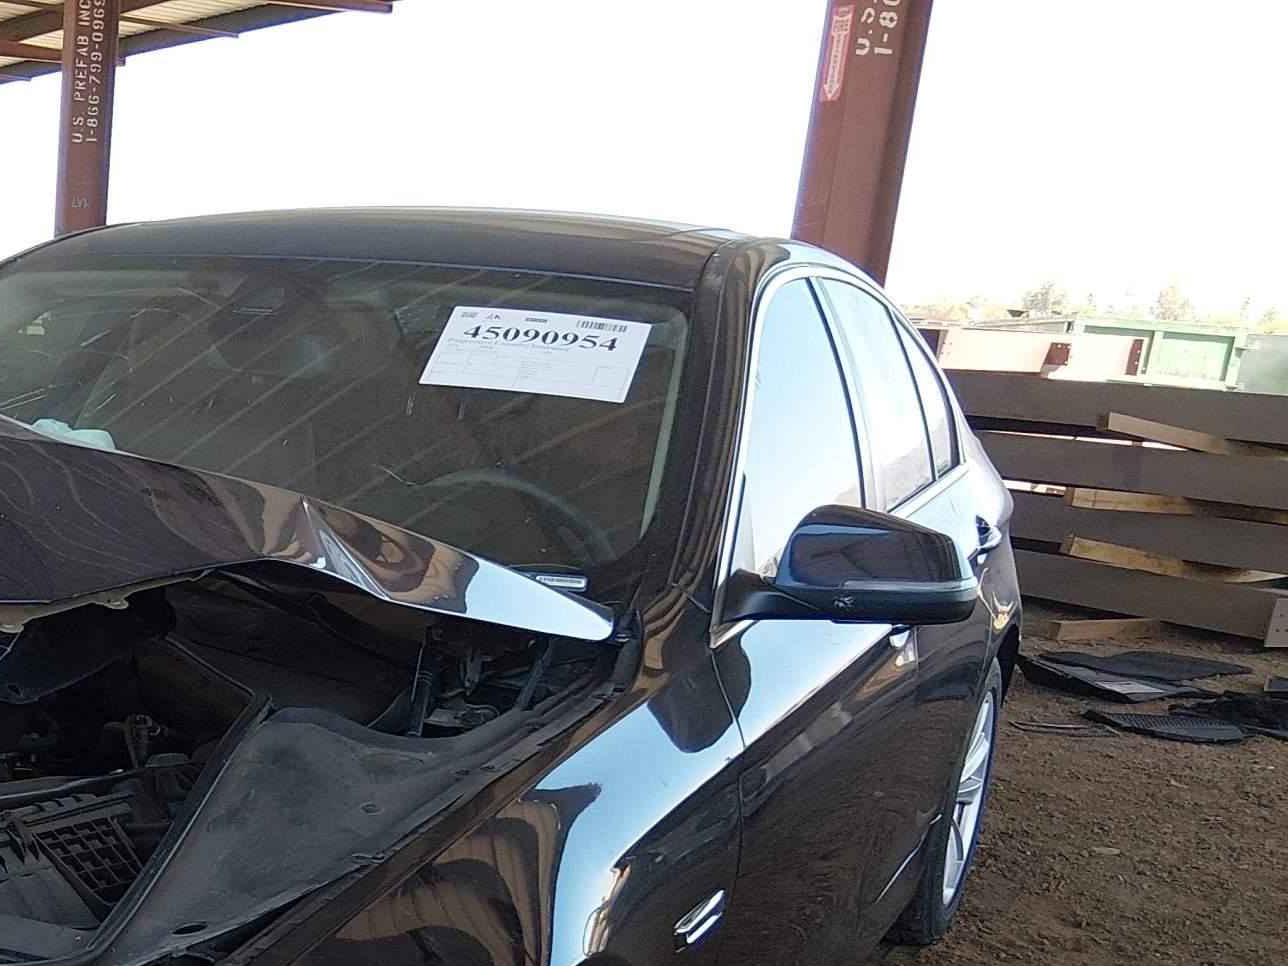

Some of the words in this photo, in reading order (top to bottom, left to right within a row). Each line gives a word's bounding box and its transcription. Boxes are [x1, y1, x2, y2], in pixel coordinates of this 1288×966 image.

[74, 35, 89, 101] PREFAB
[72, 112, 85, 143] U.S.
[463, 324, 618, 352] 45090954
